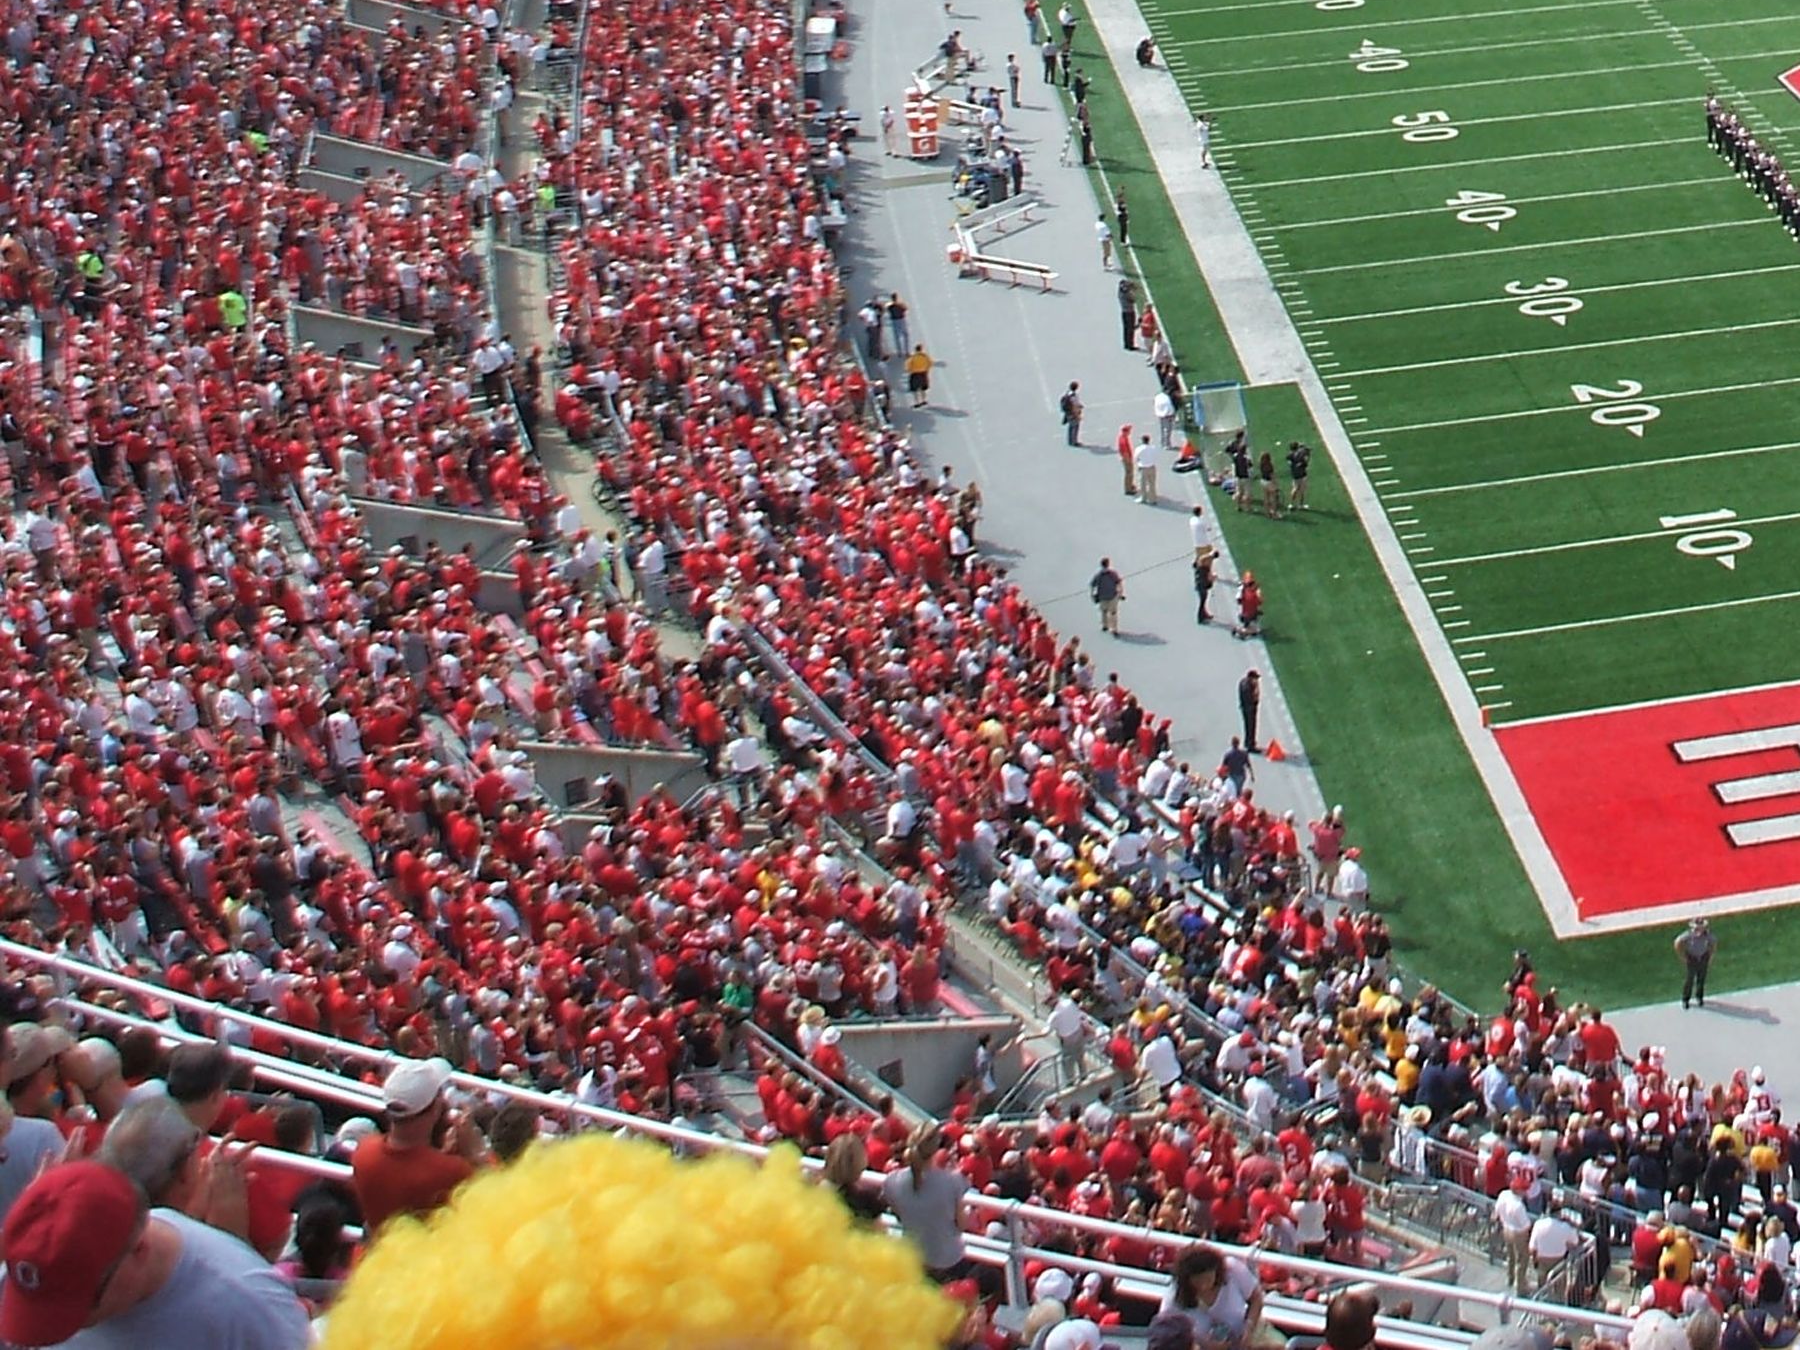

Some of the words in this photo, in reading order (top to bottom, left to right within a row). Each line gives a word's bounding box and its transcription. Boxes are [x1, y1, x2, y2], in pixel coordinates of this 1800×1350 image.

[1349, 46, 1410, 72] 40
[1392, 110, 1459, 142] 50
[1446, 189, 1518, 224] 40
[1504, 276, 1584, 317] 30
[1571, 379, 1661, 426] 20
[1658, 507, 1754, 556] 10
